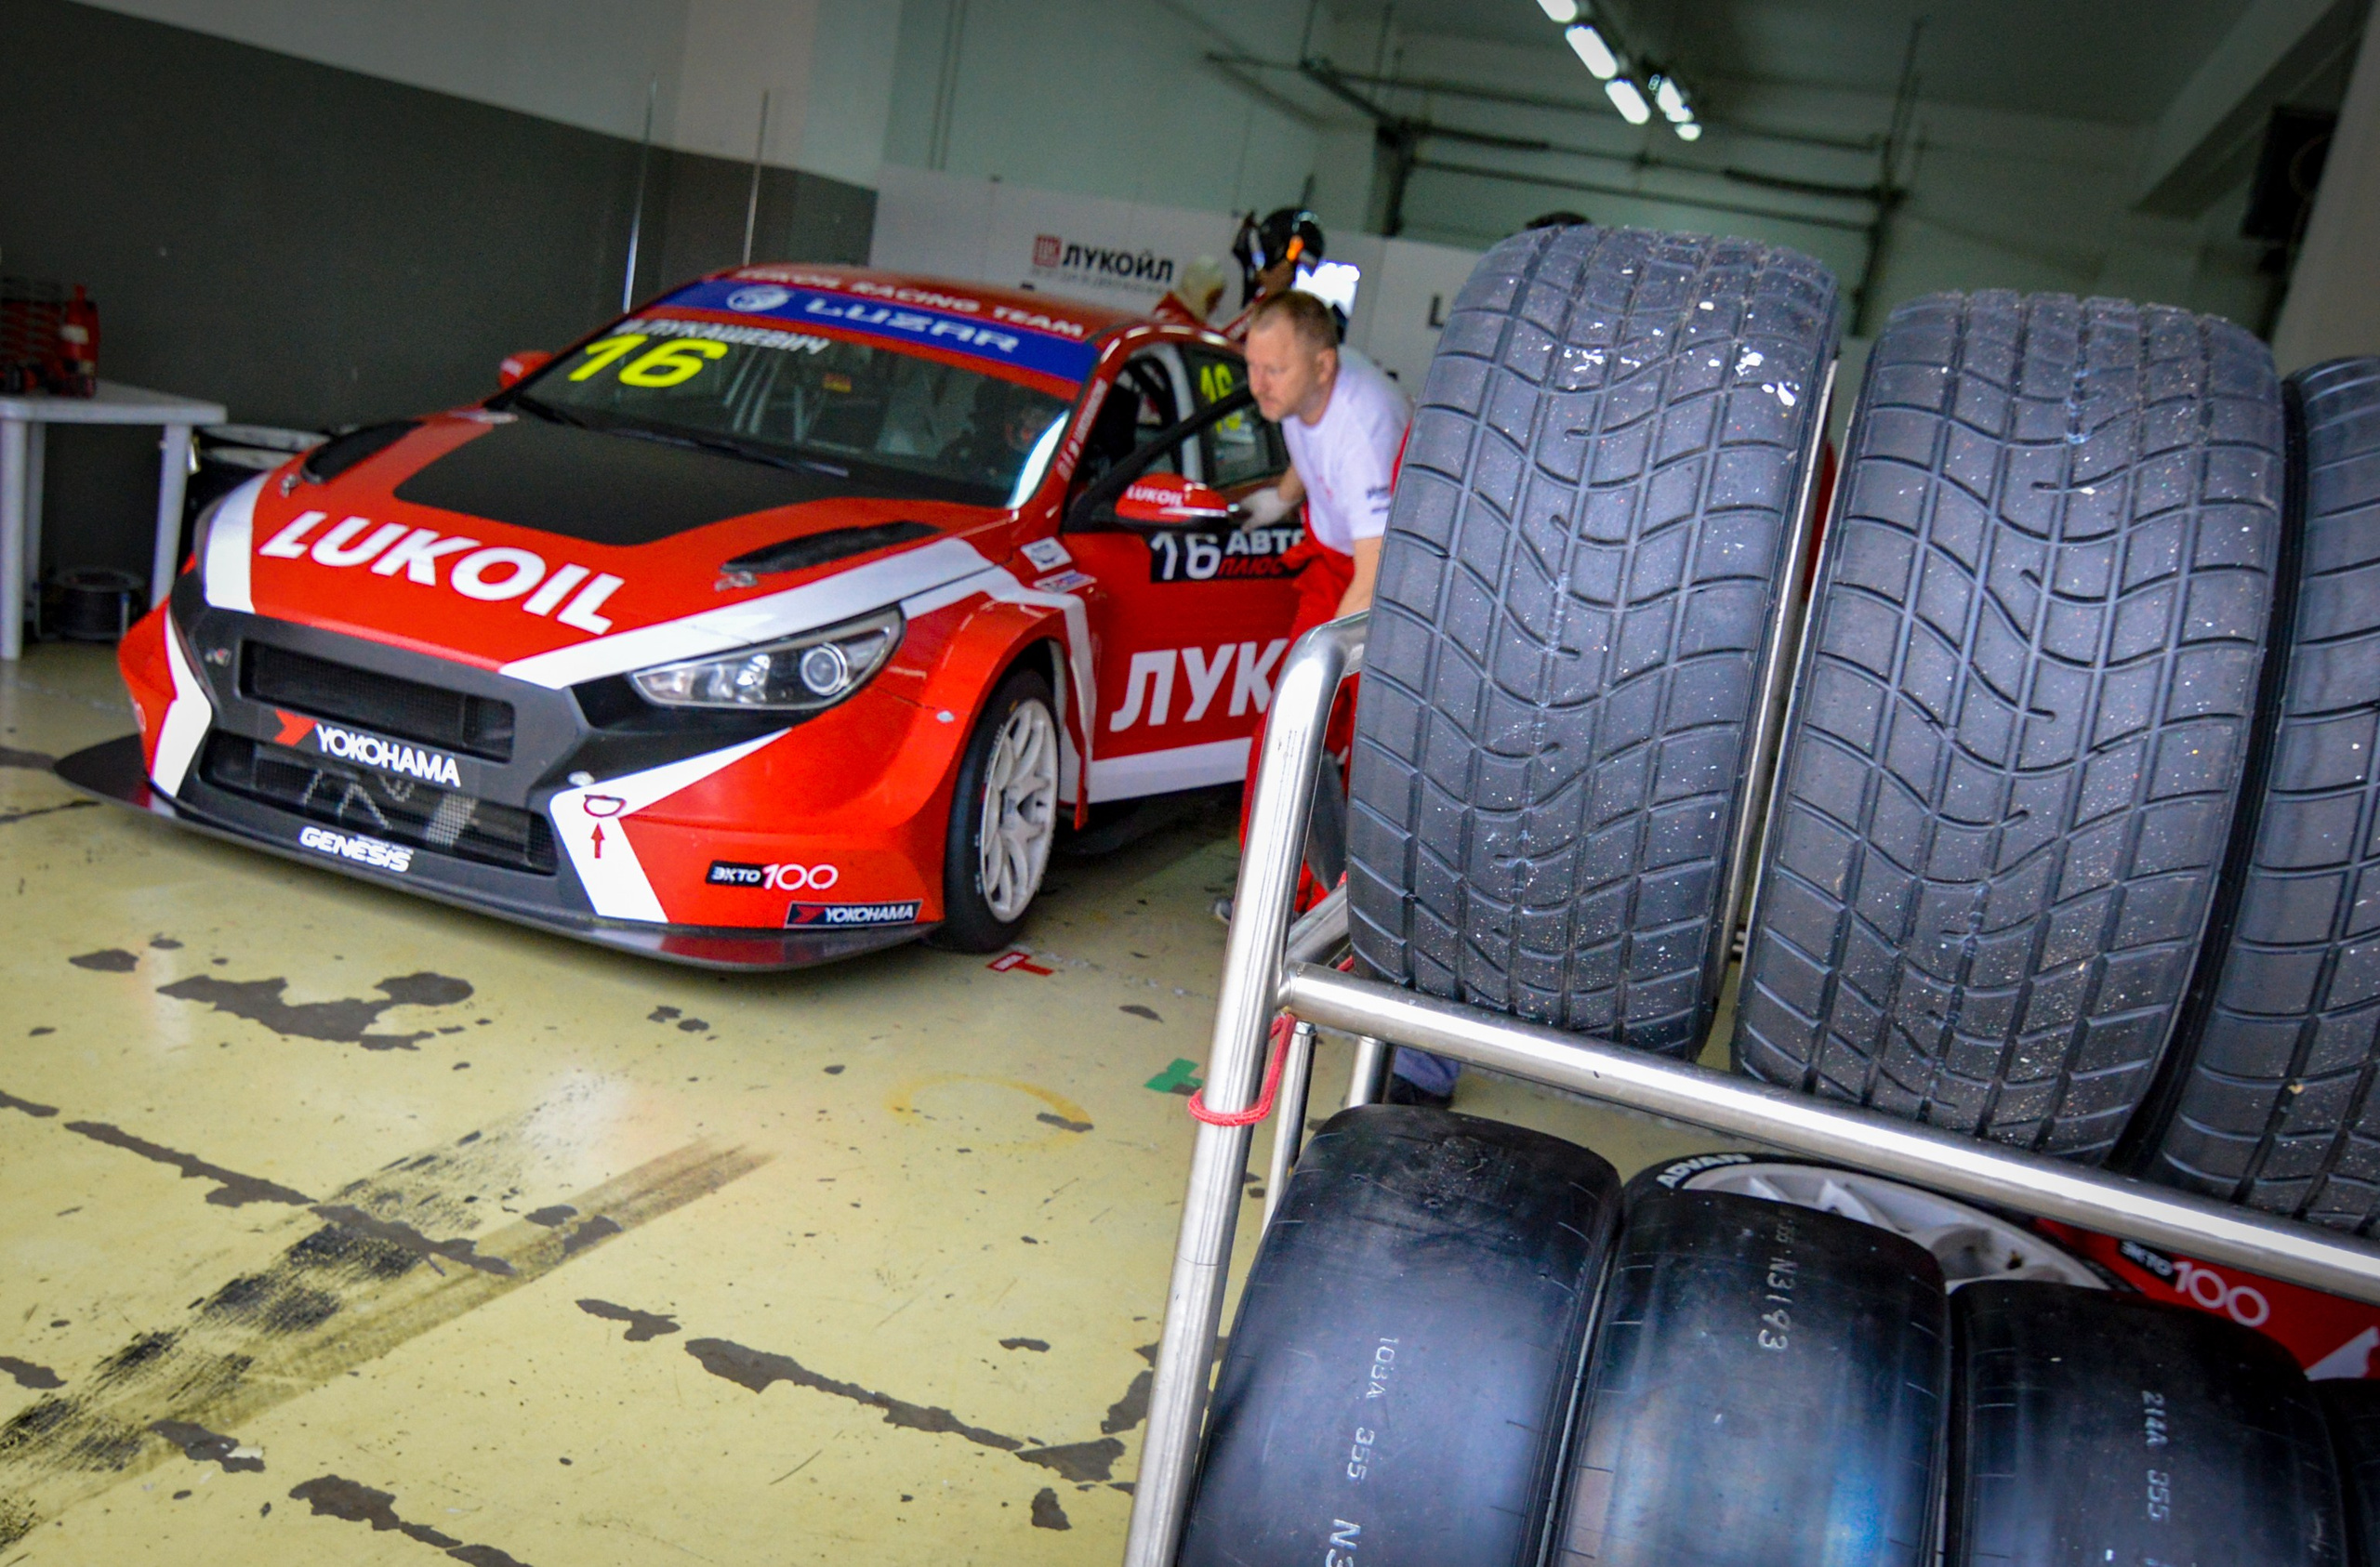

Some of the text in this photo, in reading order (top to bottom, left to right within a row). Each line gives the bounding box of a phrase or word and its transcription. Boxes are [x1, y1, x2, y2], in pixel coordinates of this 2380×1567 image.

[1063, 244, 1173, 283] ЛУКОЙЛ
[804, 297, 1020, 353] LUZAR
[850, 281, 980, 312] RACING
[993, 305, 1084, 337] TEAM
[568, 333, 729, 388] 16
[1126, 484, 1184, 507] LUKOIL
[258, 509, 625, 636] LUKOIL
[1150, 532, 1223, 581] 16
[313, 722, 462, 788] YOKOHAMA
[298, 825, 413, 873] GENESIS
[762, 863, 840, 890] 100
[824, 903, 915, 923] YOKOHAMA
[1656, 1153, 1752, 1190] ADVAN
[1347, 1427, 1375, 1481] 355
[2146, 1468, 2171, 1524] 355
